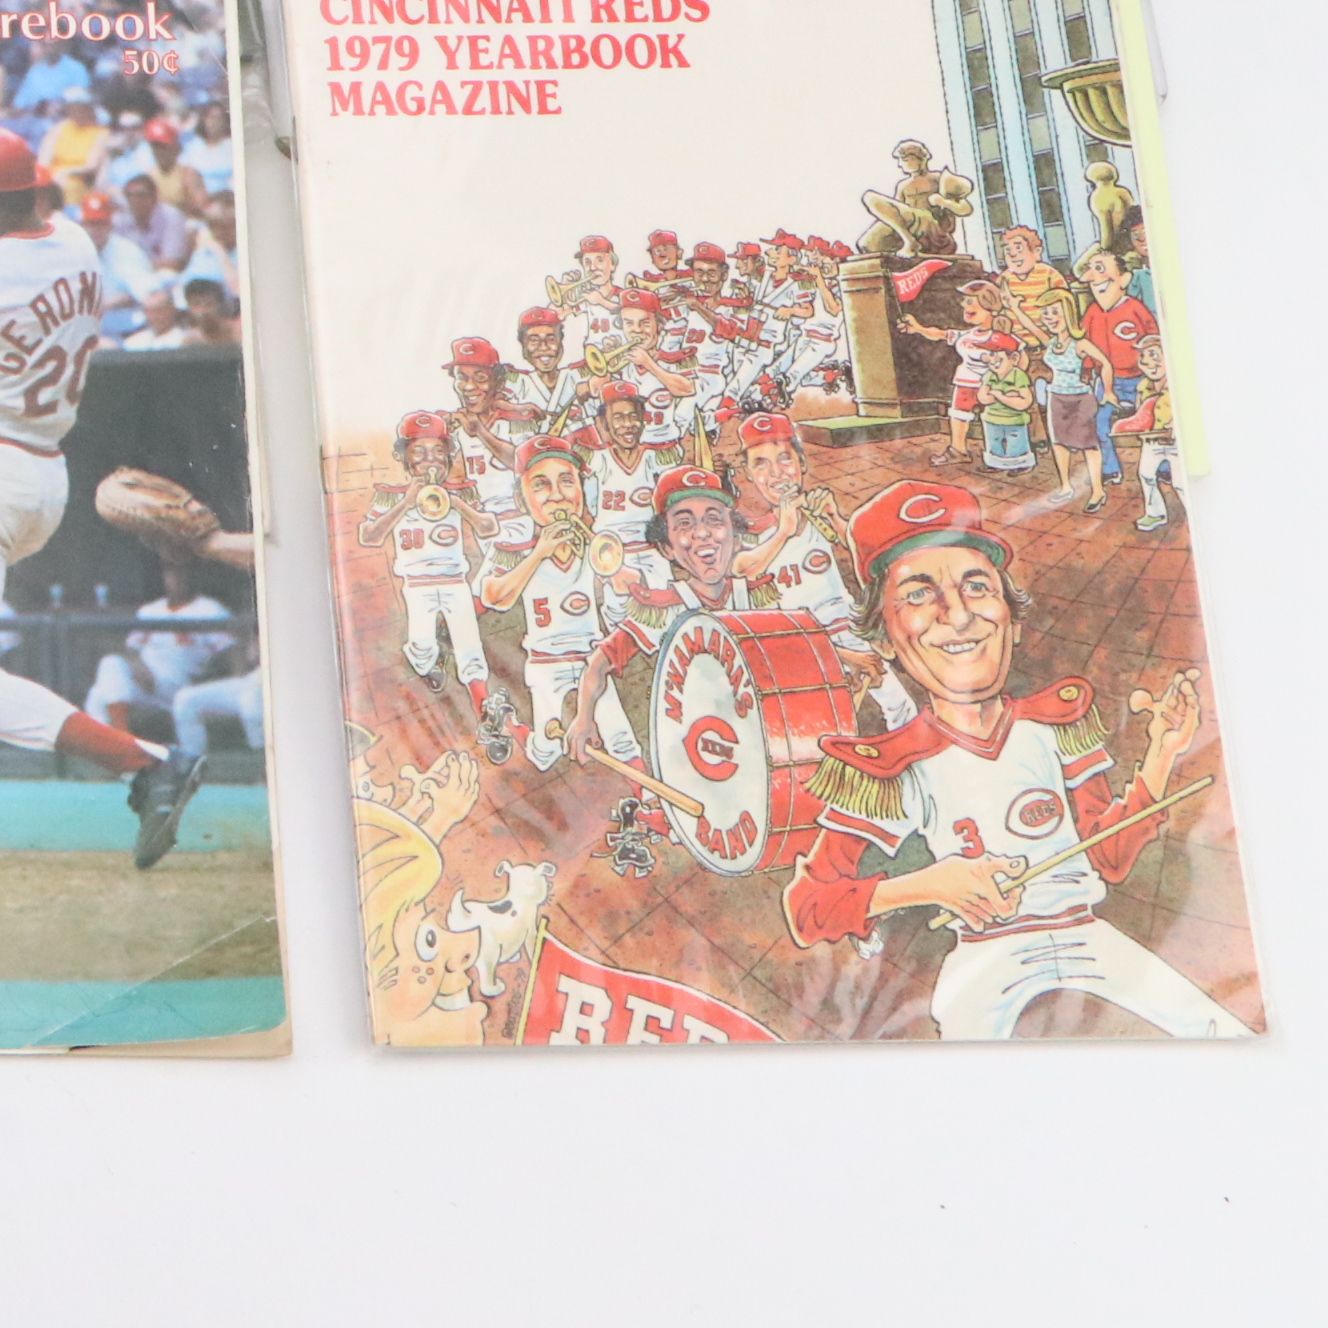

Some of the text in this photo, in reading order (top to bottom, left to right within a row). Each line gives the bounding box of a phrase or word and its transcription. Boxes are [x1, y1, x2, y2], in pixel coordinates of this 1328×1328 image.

[324, 32, 691, 73] 1979 YEARBOOK
[328, 78, 563, 118] MAGAZINE
[600, 489, 626, 510] 22
[776, 564, 803, 588] 41
[533, 597, 551, 628] 5
[695, 809, 759, 860] BAND
